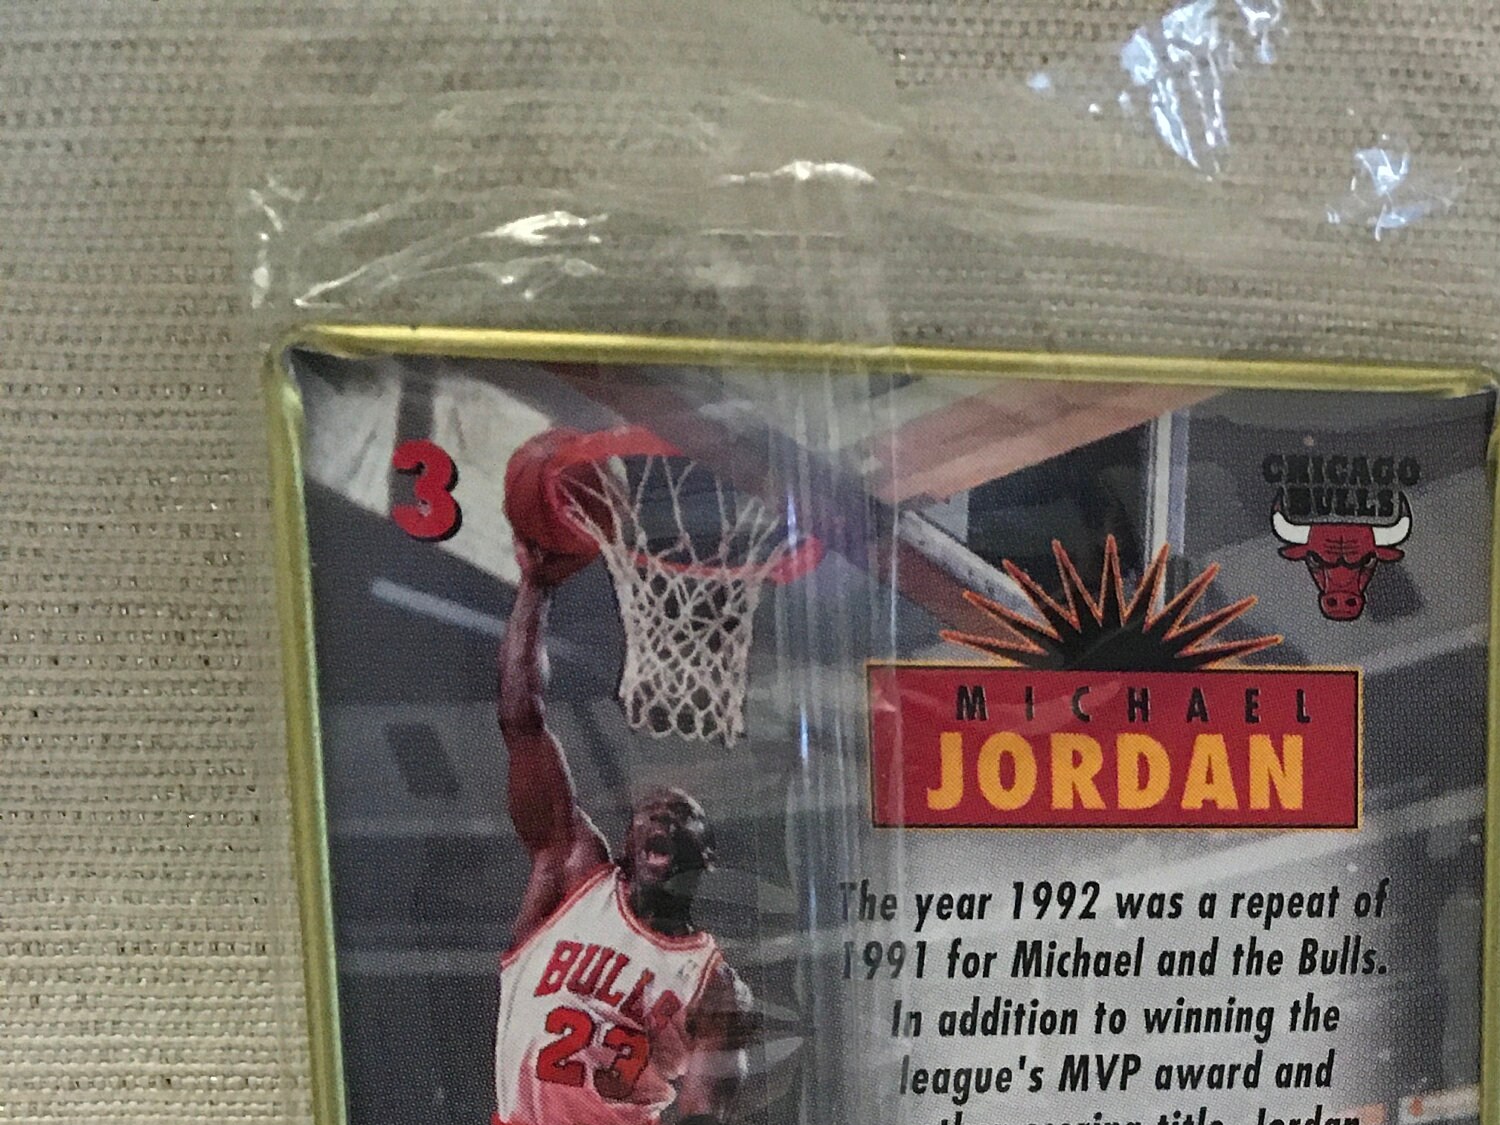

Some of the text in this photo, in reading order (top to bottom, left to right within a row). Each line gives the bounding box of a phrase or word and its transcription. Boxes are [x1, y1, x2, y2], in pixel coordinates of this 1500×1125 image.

[392, 438, 462, 541] 3
[1262, 454, 1421, 486] CHICAGO
[1286, 487, 1395, 516] BULLS
[956, 685, 1310, 724] MICHAEL
[927, 731, 1304, 810] JORDAN
[840, 878, 1390, 932] The year 1992 was a repeat of
[842, 934, 1388, 979] 1991 for Michael and the Bulls.
[892, 992, 1340, 1043] In addition to winning the
[536, 1005, 649, 1103] 23
[899, 1048, 1334, 1105] league's MVP award and
